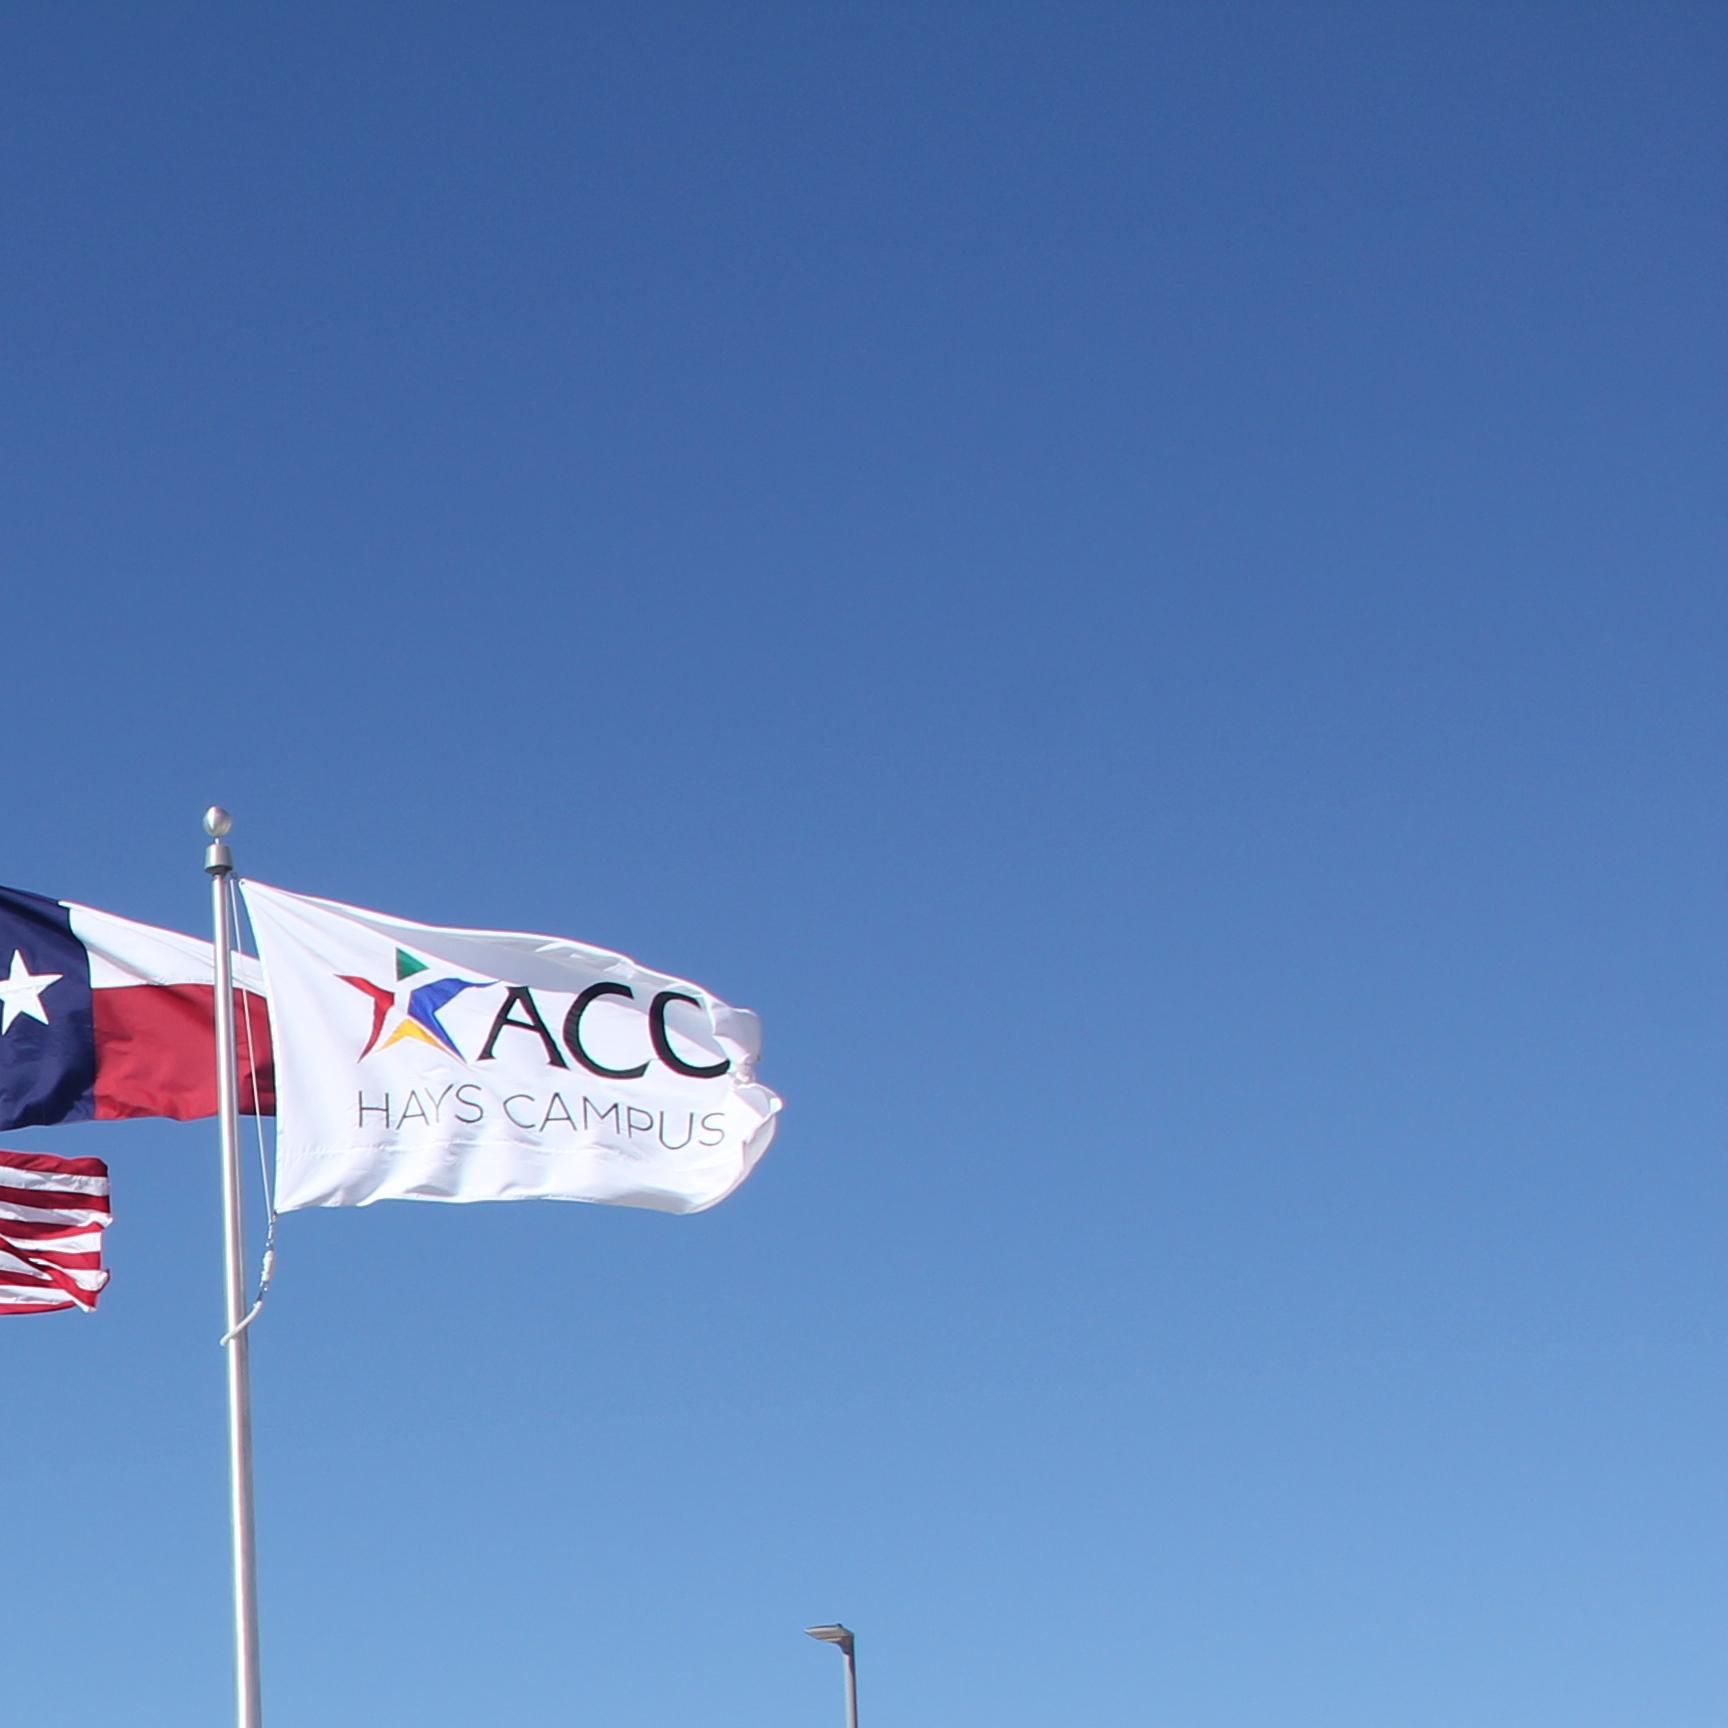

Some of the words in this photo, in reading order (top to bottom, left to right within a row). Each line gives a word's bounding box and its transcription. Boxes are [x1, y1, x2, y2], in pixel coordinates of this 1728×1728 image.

[476, 981, 732, 1080] ACC
[355, 1083, 485, 1133] HAYS
[503, 1091, 726, 1151] CAMPUS
